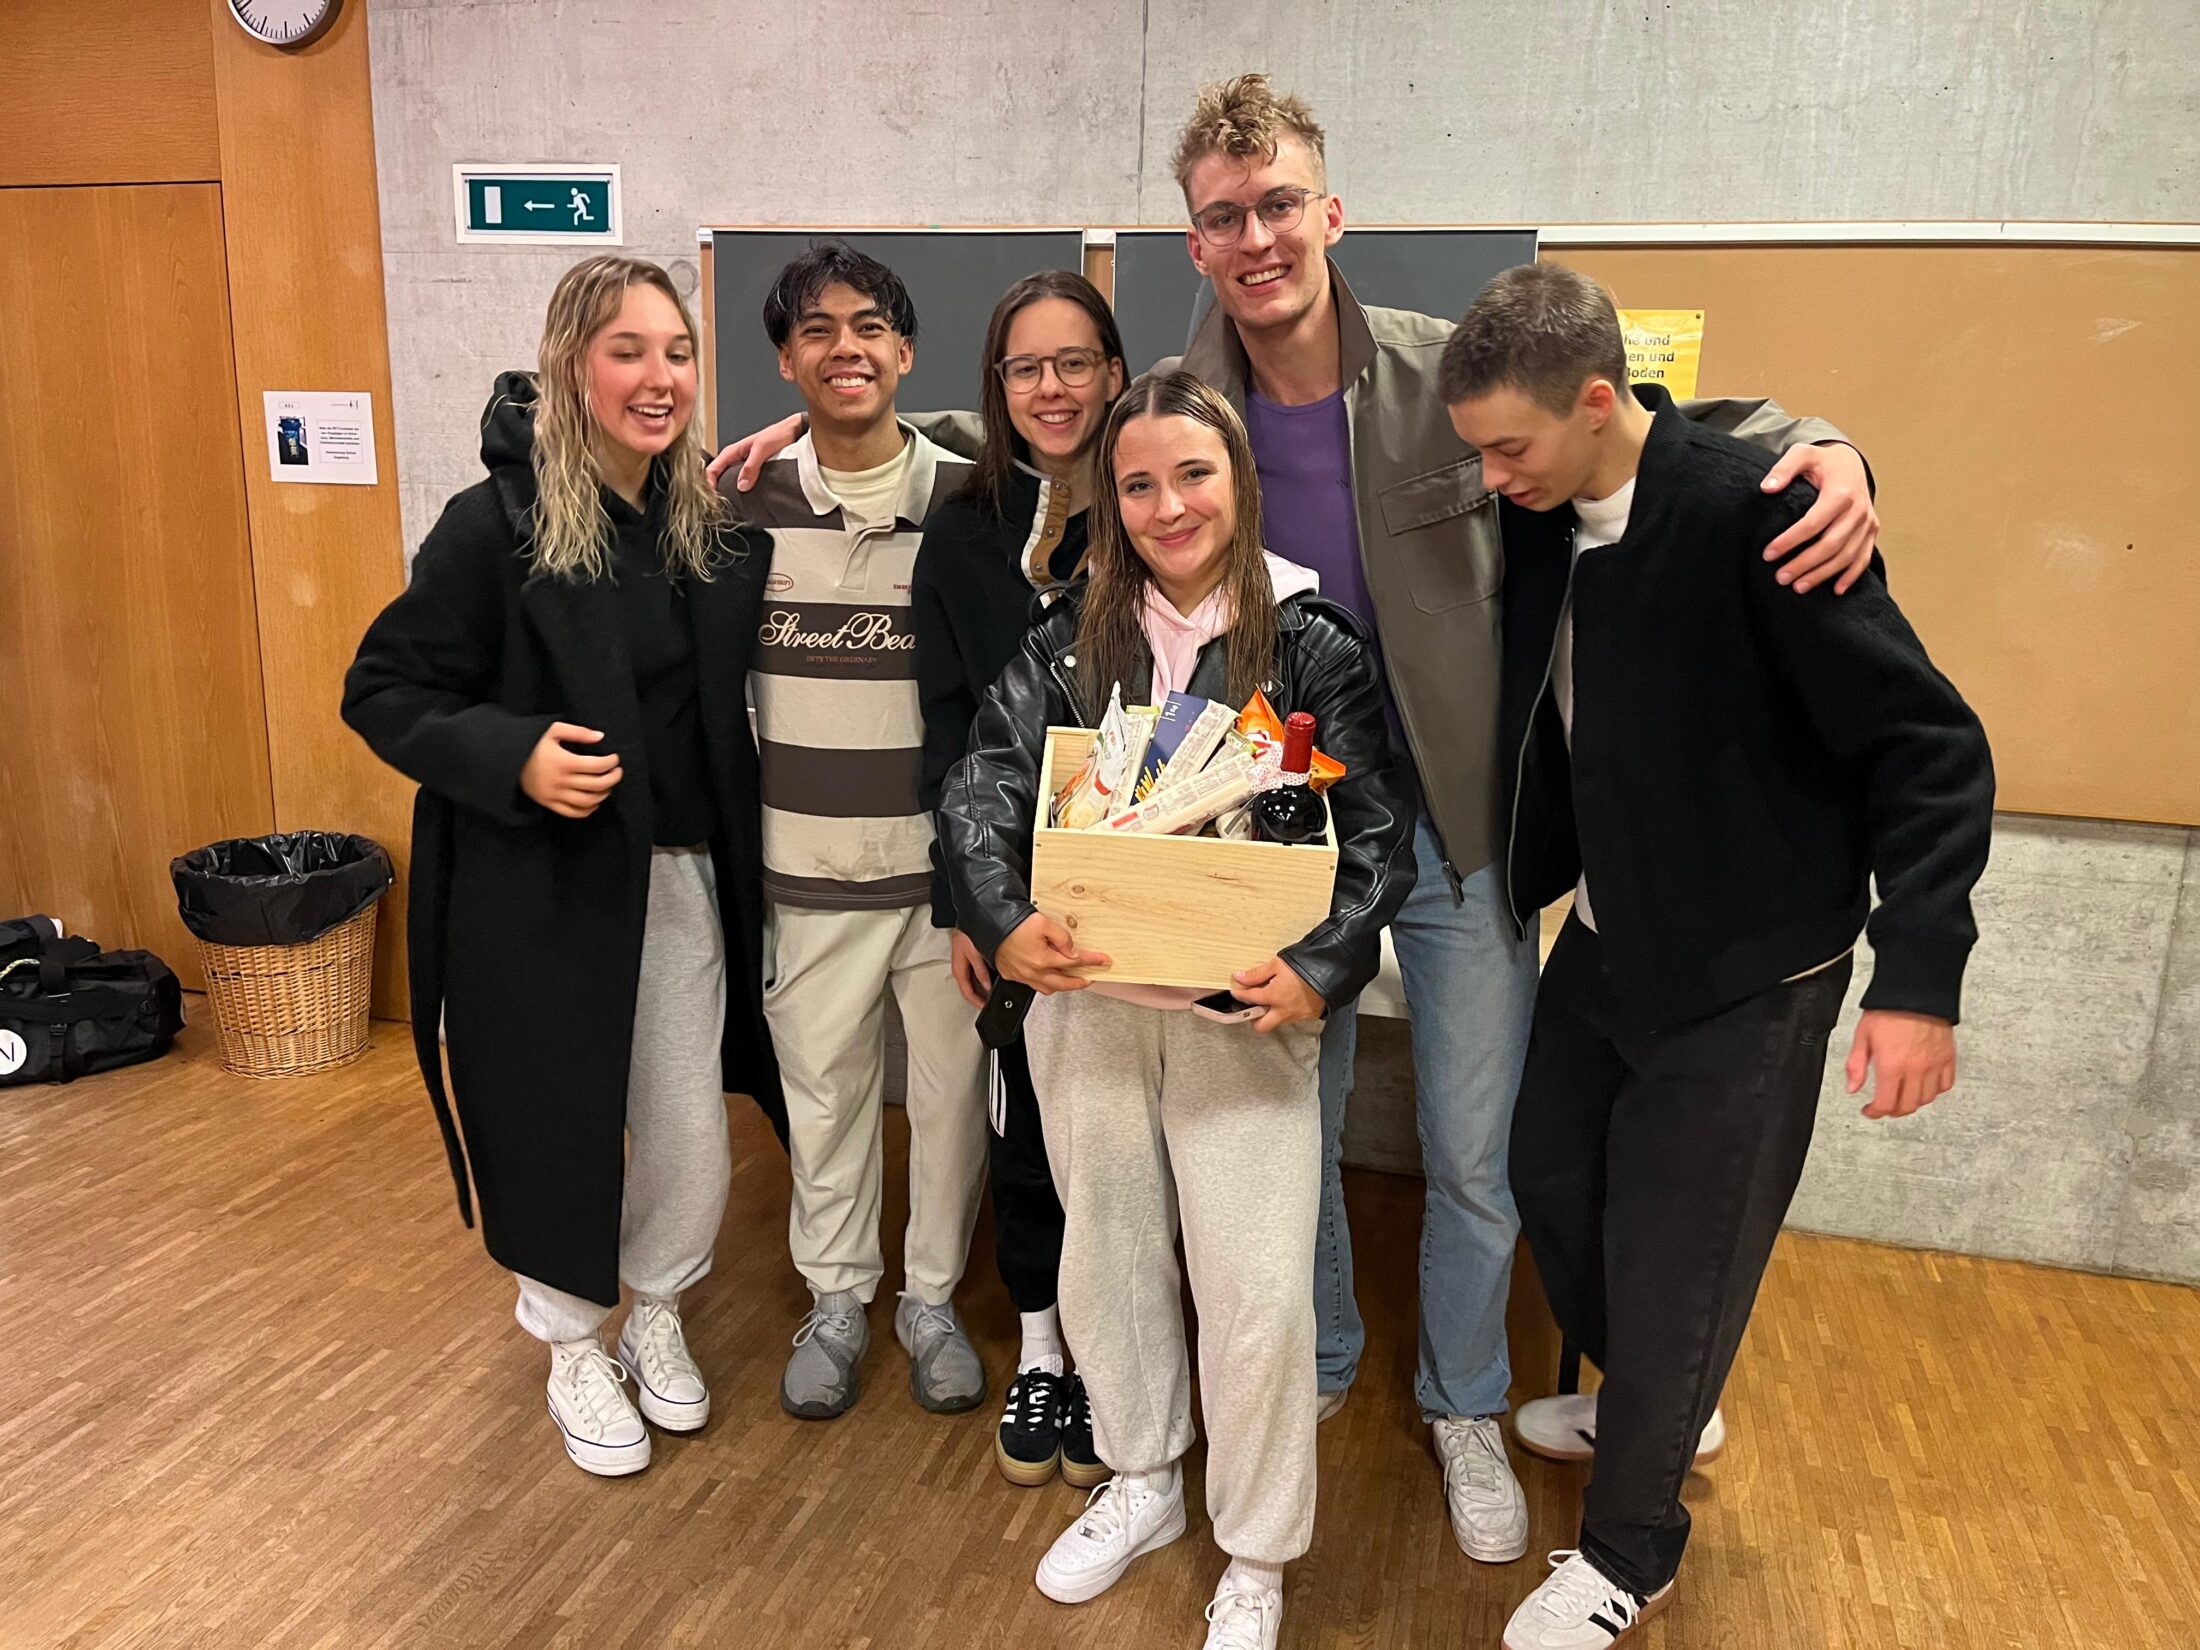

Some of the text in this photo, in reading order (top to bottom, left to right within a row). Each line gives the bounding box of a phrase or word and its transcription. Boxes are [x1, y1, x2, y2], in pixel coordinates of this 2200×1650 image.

[1623, 334, 1670, 346] he und
[1628, 352, 1675, 362] en und
[758, 610, 916, 650] Street Bea
